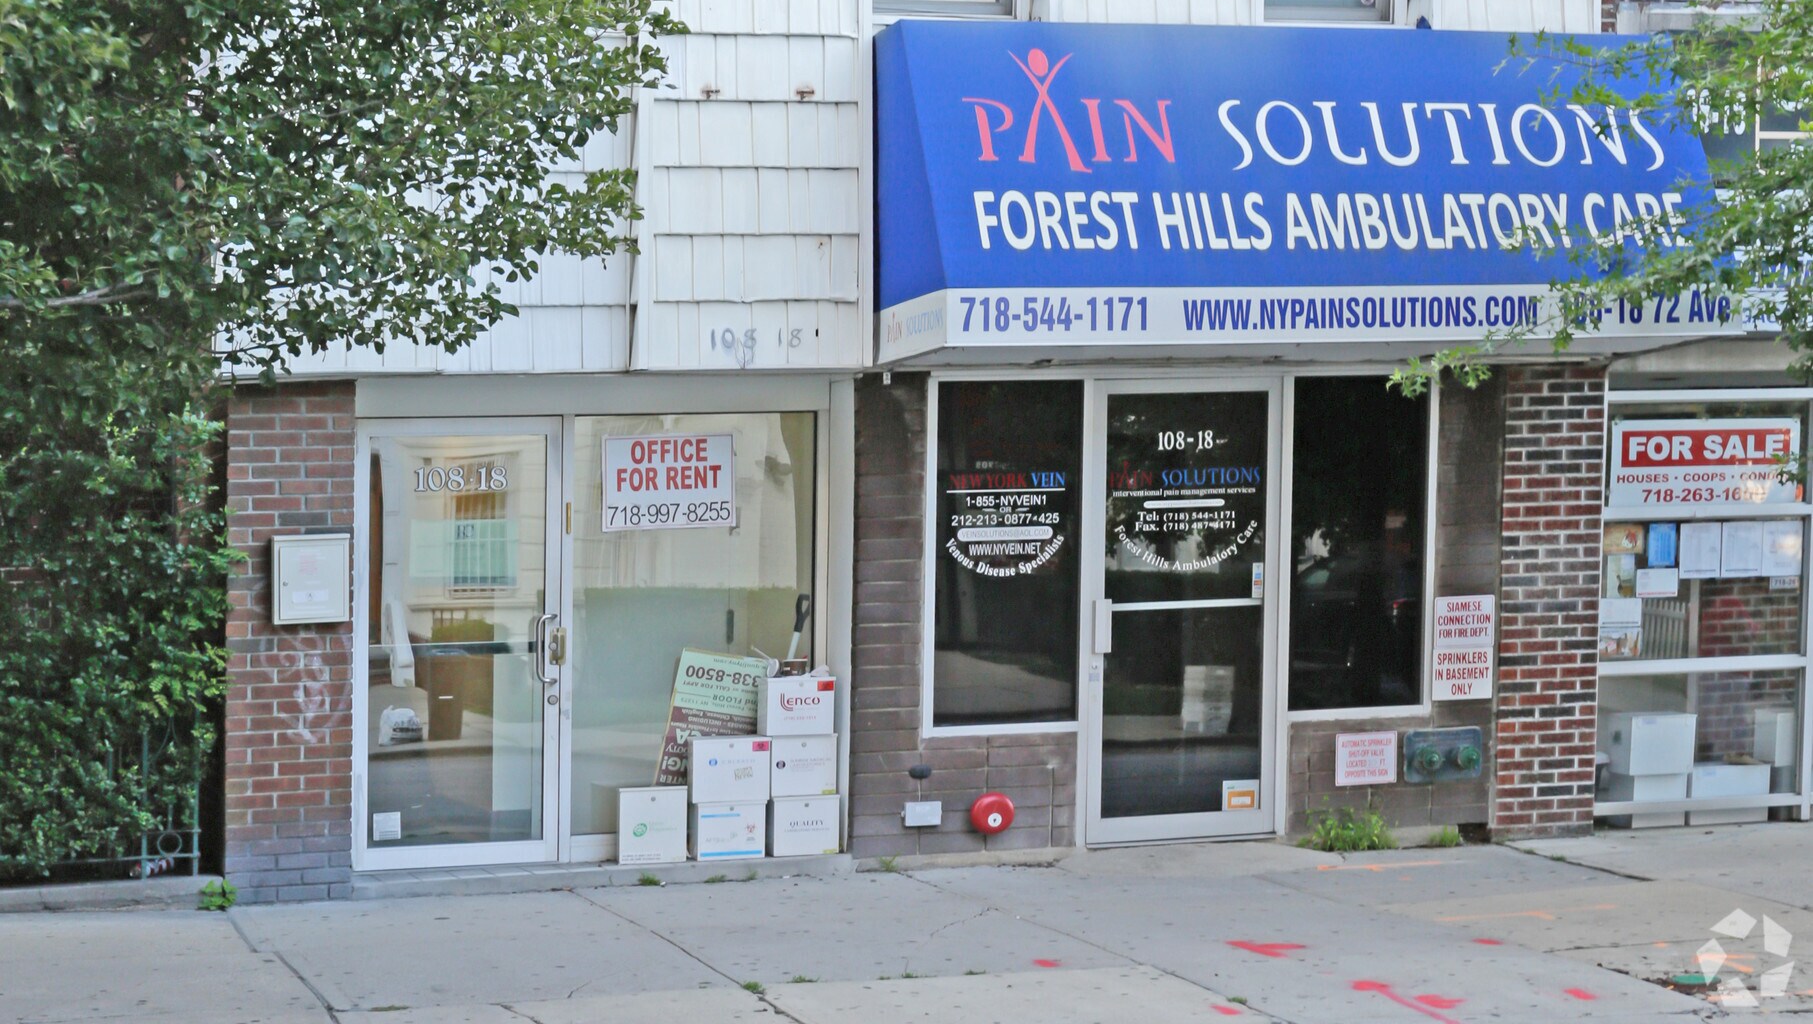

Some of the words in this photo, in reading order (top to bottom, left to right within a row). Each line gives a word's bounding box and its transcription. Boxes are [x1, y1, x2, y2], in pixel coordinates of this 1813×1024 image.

[961, 48, 1177, 174] PAIN
[1217, 98, 1666, 172] SOLUTIONS
[972, 189, 1140, 251] FOREST
[1151, 190, 1273, 251] HILLS
[1286, 190, 1573, 251] AMBULATORY
[1582, 191, 1695, 248] CARE
[959, 295, 1148, 332] 718-544-1171
[1182, 293, 1539, 331] WWW.NYPAINSOLUTIONS.COM
[1652, 288, 1680, 323] 72
[1688, 287, 1731, 323] Ave
[1158, 430, 1213, 451] 108-18
[631, 438, 708, 464] OFFICE
[1628, 435, 1693, 462] FOR
[1703, 434, 1785, 461] SALE
[617, 467, 659, 493] FOR
[666, 465, 722, 491] RENT
[950, 473, 982, 489] NEW
[986, 472, 1028, 488] YORK
[1031, 471, 1066, 487] VEIN
[1161, 466, 1261, 487] SOLUTIONS
[1617, 473, 1669, 484] HOUSES
[1683, 472, 1726, 482] COOPS
[1112, 488, 1163, 497] interventional
[1164, 488, 1180, 497] pain
[1181, 487, 1226, 496] management
[1227, 486, 1256, 495] services
[965, 494, 1047, 507] 1-855-NYVEIN1
[607, 501, 731, 526] 718-997-8255
[999, 506, 1012, 514] OR
[1163, 511, 1189, 522] (718)
[1191, 510, 1235, 520] 544-1171
[1163, 522, 1189, 532] (718)
[968, 542, 1042, 556] WWW.NYVEIN.NET
[1113, 525, 1142, 557] Forest
[1142, 551, 1169, 570] Hills
[1172, 543, 1239, 572] Ambulatory
[1236, 519, 1258, 545] Care
[945, 538, 975, 570] Venous
[976, 561, 1016, 577] Disease
[1018, 534, 1065, 574] Specialists
[1446, 600, 1482, 613] SIAMESE
[1437, 613, 1491, 626] CONNECTION
[1438, 628, 1453, 639] FOR
[1454, 627, 1469, 638] FIRE
[1437, 651, 1488, 666] SPRINKLERS
[1435, 668, 1444, 681] IN
[1446, 666, 1490, 680] BASEMENT
[1451, 682, 1473, 696] ONLY
[712, 694, 742, 703] FLOOR
[687, 716, 721, 724] INCLUDING
[1341, 739, 1367, 748] AUTOMATIC
[1367, 737, 1392, 747] SPRINKLER
[1371, 747, 1385, 757] VALVE
[1346, 759, 1368, 769] LOCATED
[789, 819, 824, 829] QUALITY
